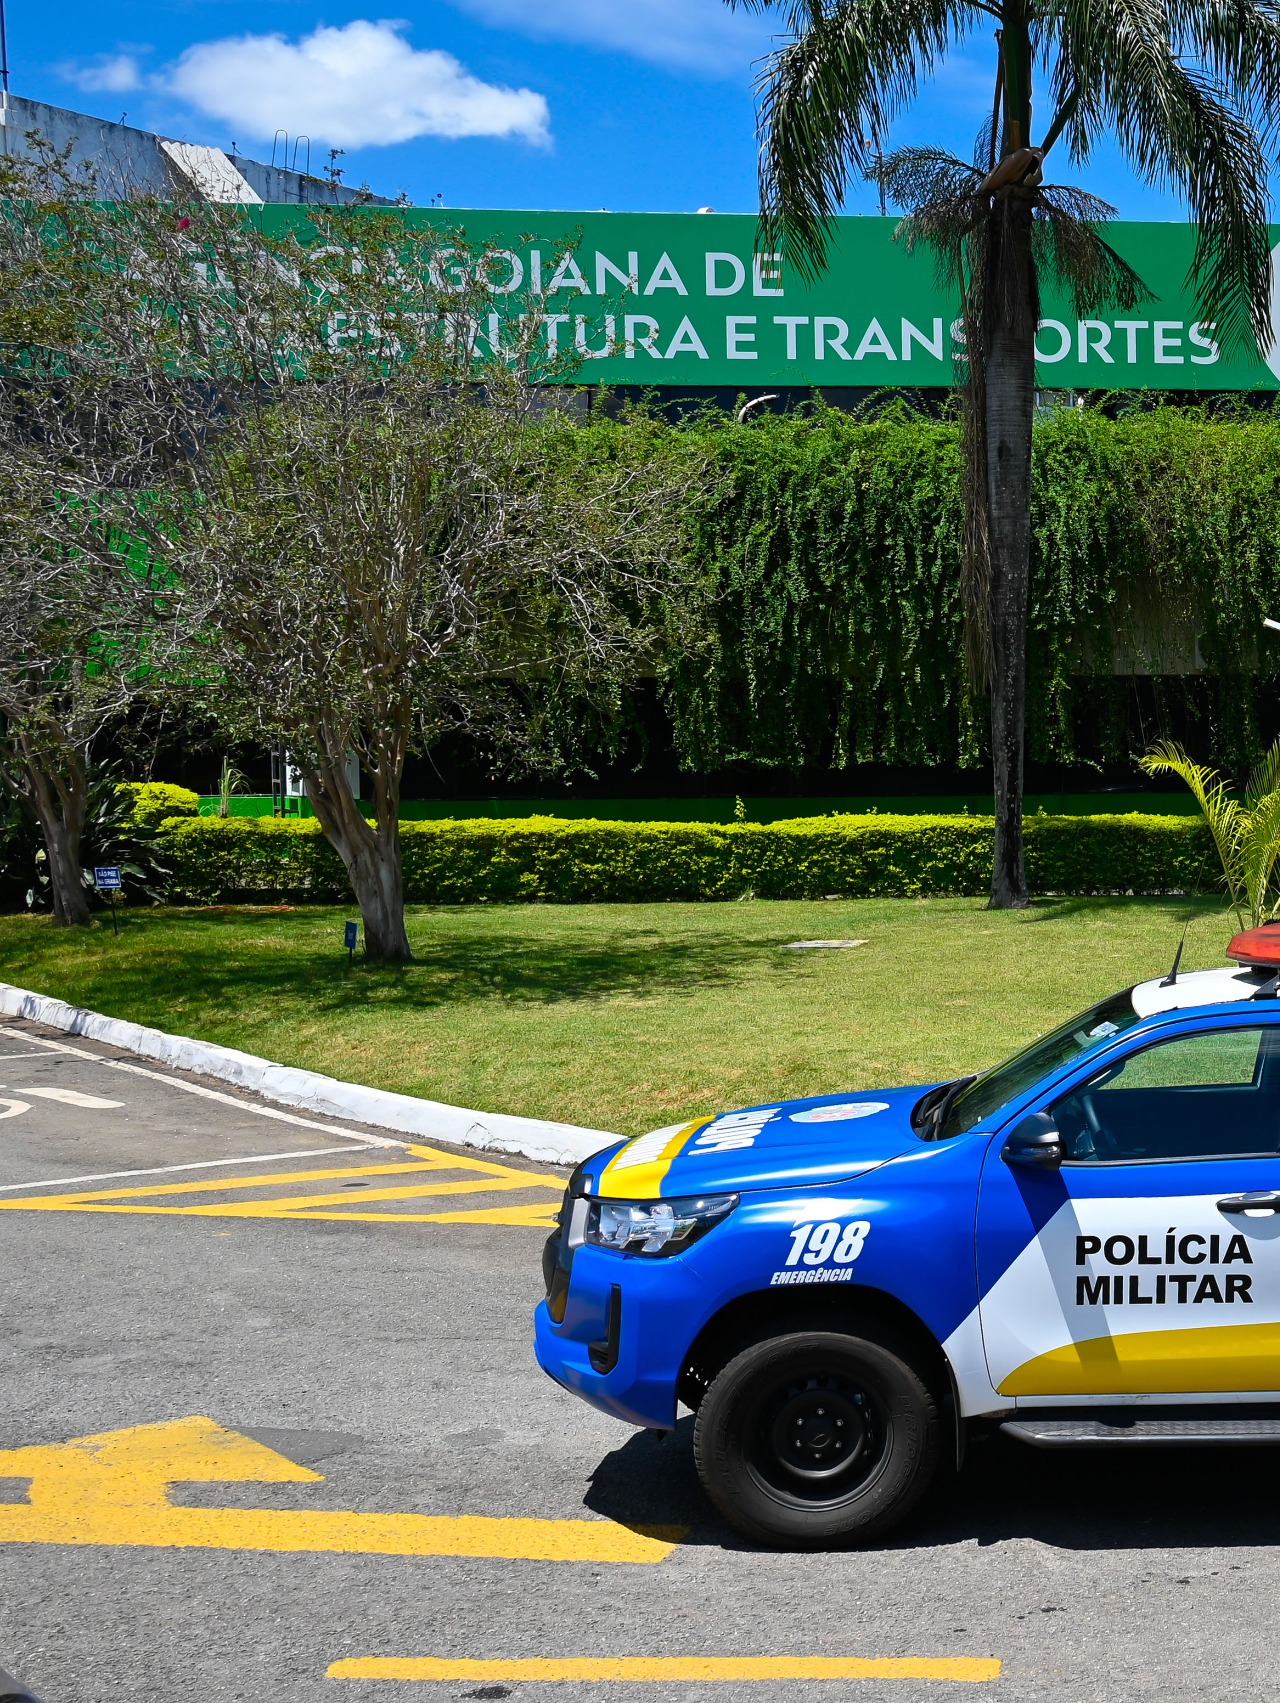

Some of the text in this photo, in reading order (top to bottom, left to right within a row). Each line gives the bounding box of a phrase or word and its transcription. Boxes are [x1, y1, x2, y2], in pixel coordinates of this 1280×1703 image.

[428, 248, 689, 296] GOIANA
[705, 252, 784, 297] DE
[726, 316, 758, 360] E
[773, 316, 1220, 366] TRANSORTES
[785, 1219, 871, 1266] 198
[1075, 1226, 1253, 1266] POLÍCIA
[770, 1266, 853, 1285] EMERGÊNCIA
[1075, 1273, 1253, 1306] MILITAR
